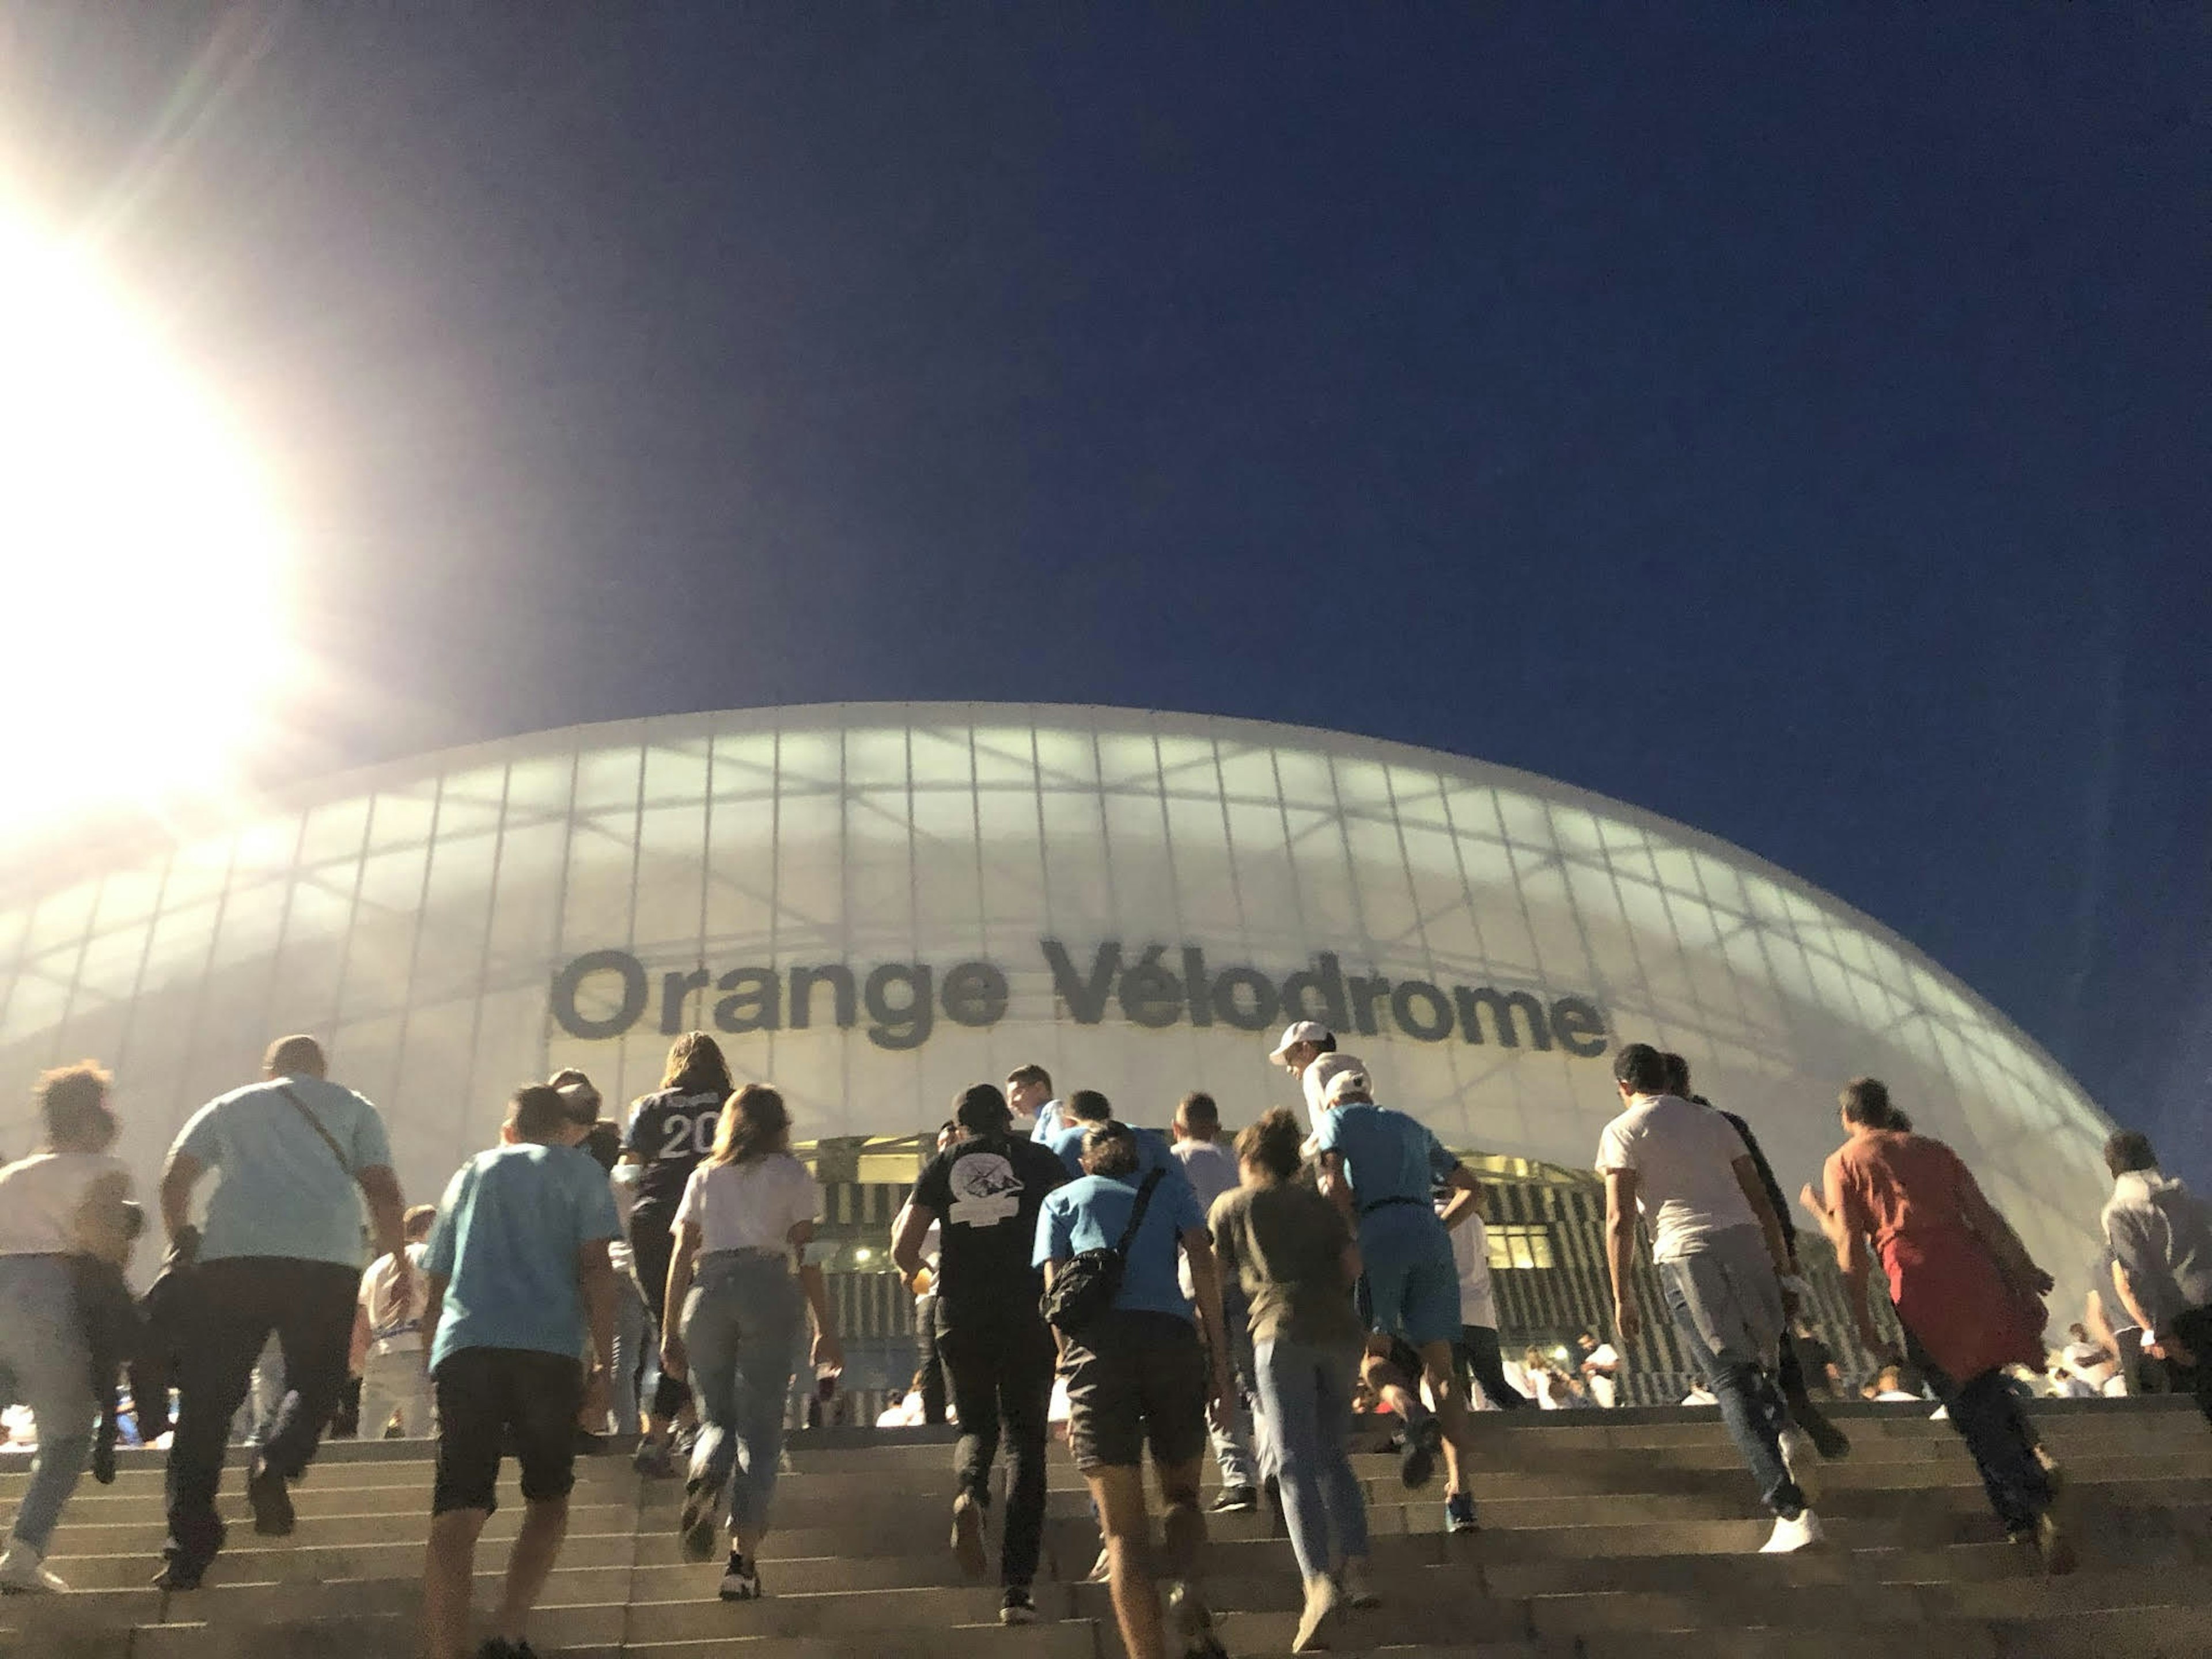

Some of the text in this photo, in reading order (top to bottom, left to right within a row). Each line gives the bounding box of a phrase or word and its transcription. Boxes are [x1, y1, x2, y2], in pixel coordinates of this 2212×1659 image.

[551, 938, 1607, 1058] Orange Vélodrome
[658, 1111, 721, 1159] 20
